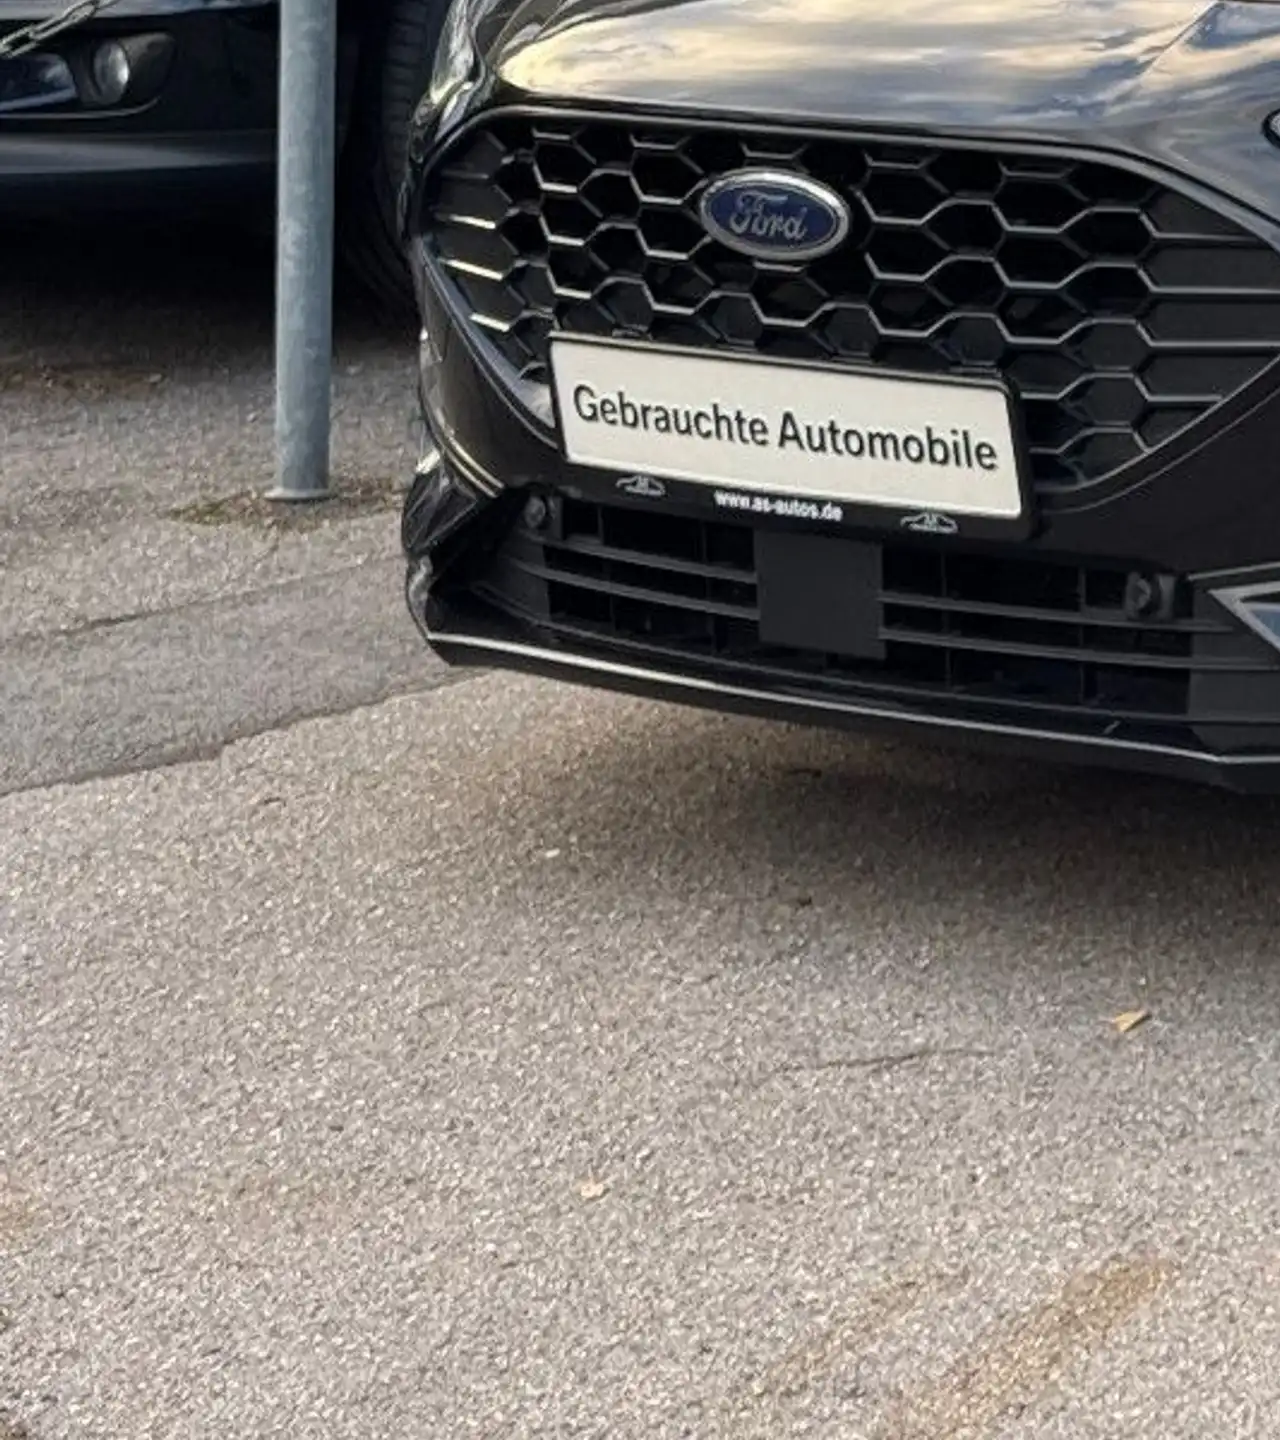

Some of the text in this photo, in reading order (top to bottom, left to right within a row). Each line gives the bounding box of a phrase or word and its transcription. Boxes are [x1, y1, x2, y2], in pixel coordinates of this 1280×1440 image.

[729, 190, 809, 241] Ford
[573, 383, 998, 471] Gebrauchte Automobile
[714, 490, 843, 522] www.as-autos.de
